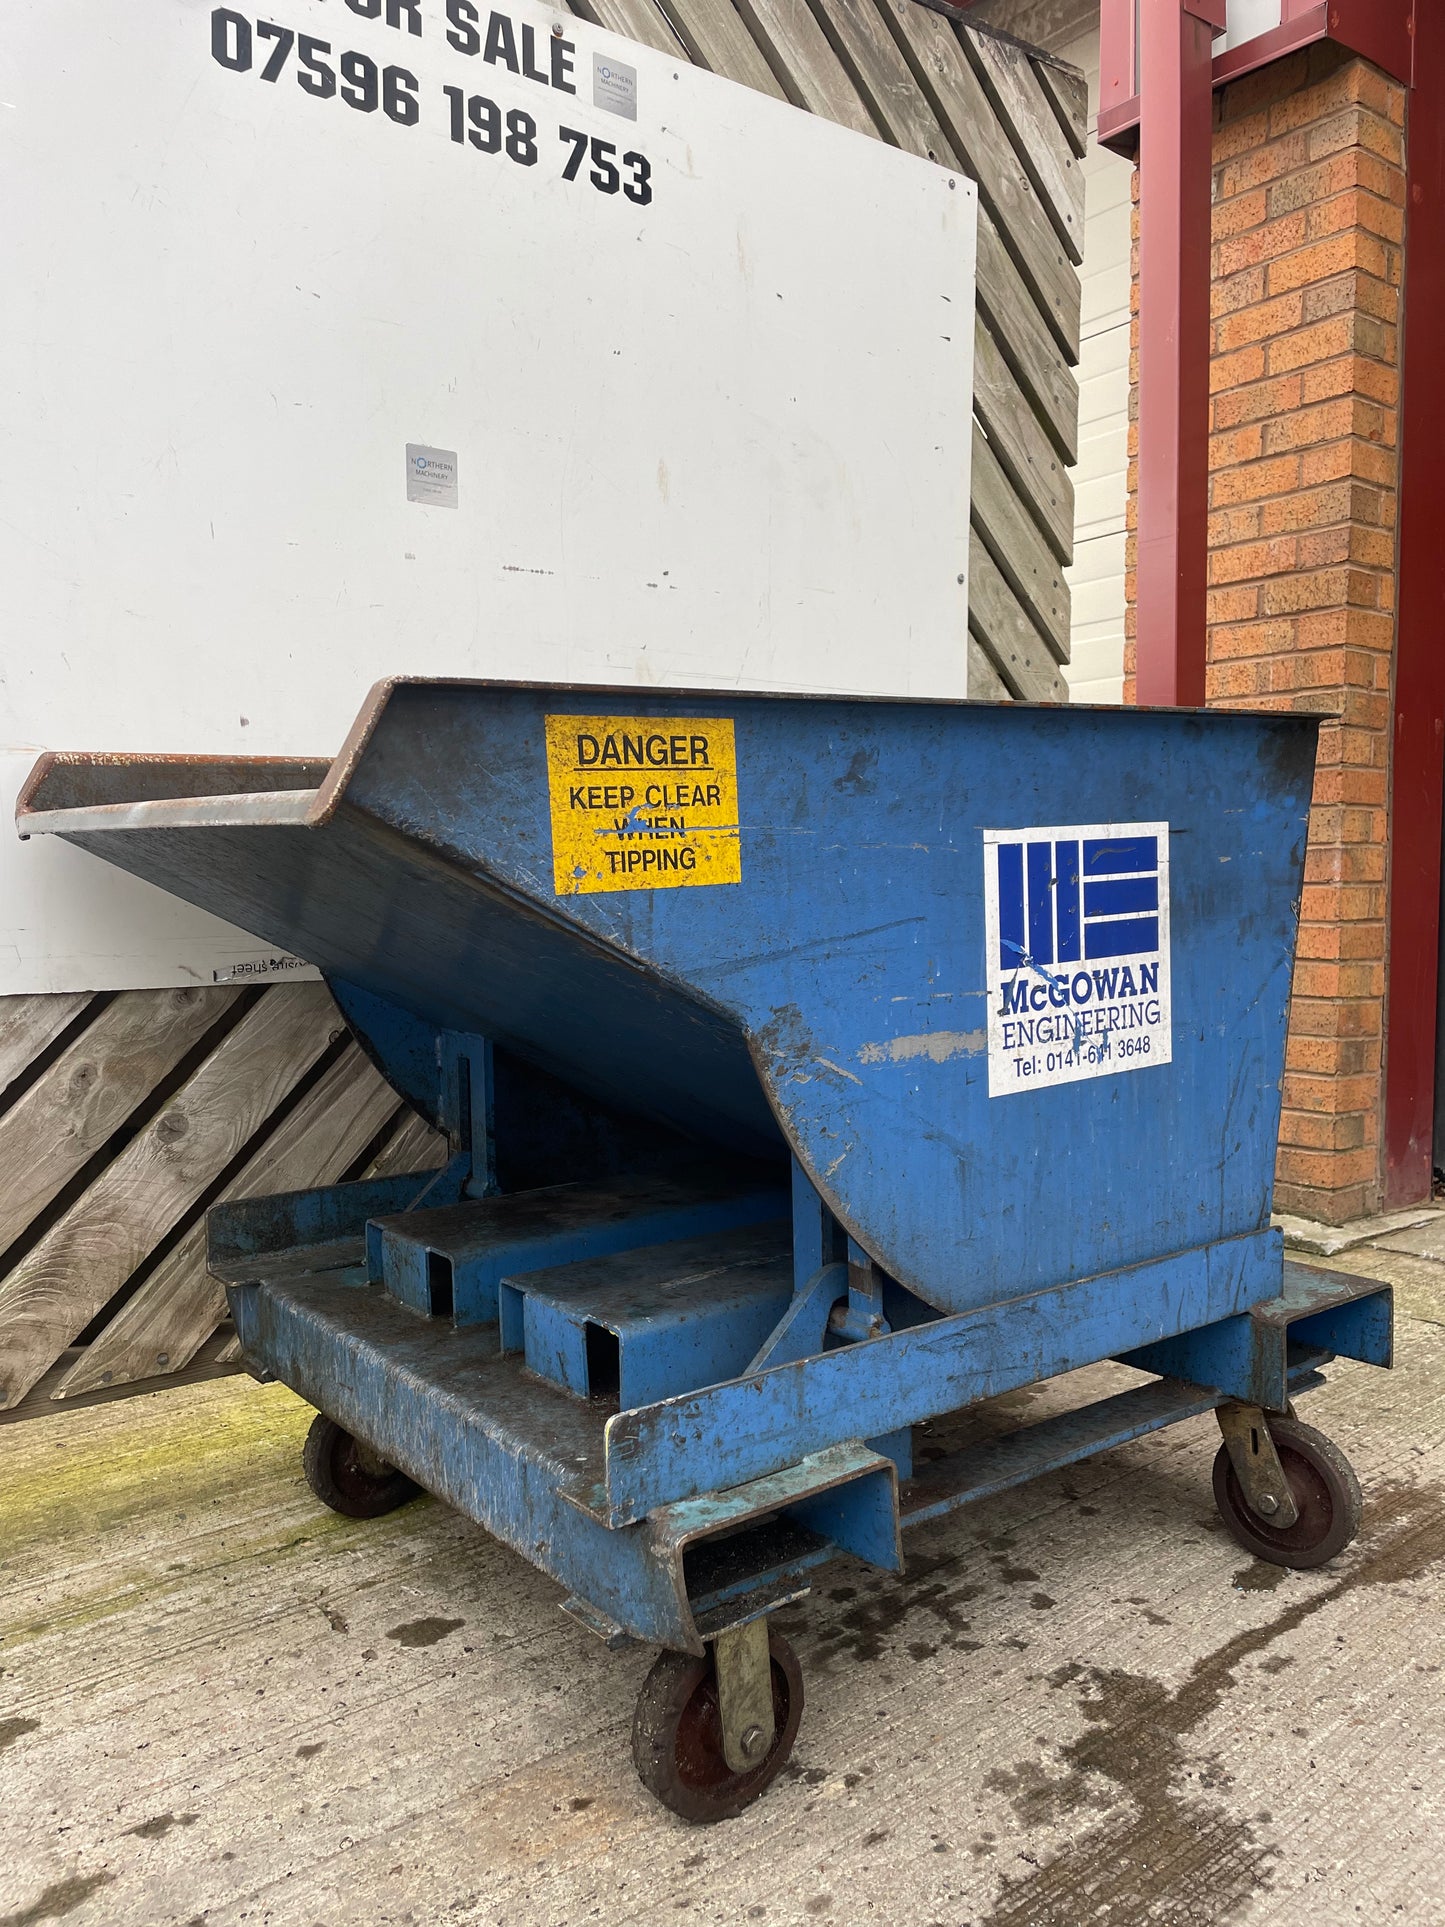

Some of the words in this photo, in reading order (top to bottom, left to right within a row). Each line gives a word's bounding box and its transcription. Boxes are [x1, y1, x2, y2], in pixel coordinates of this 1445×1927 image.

[446, 0, 577, 96] SALE
[597, 66, 633, 86] NORTHERN
[601, 78, 629, 93] MACHINERY
[211, 7, 420, 127] 07596
[443, 85, 538, 167] 198
[558, 125, 653, 206] 753
[411, 457, 453, 472] NORTHERN
[415, 469, 448, 480] MACHINERY
[577, 734, 710, 765] DANGER
[569, 786, 635, 810] KEEP
[645, 784, 721, 808] CLEAR
[606, 847, 697, 874] TIPPING
[231, 960, 268, 975] sheet
[1000, 962, 1159, 1016] McGOWAN
[1002, 1000, 1161, 1050] ENGINEERING
[1013, 1055, 1042, 1078] Tel:
[1118, 1035, 1151, 1059] 3648
